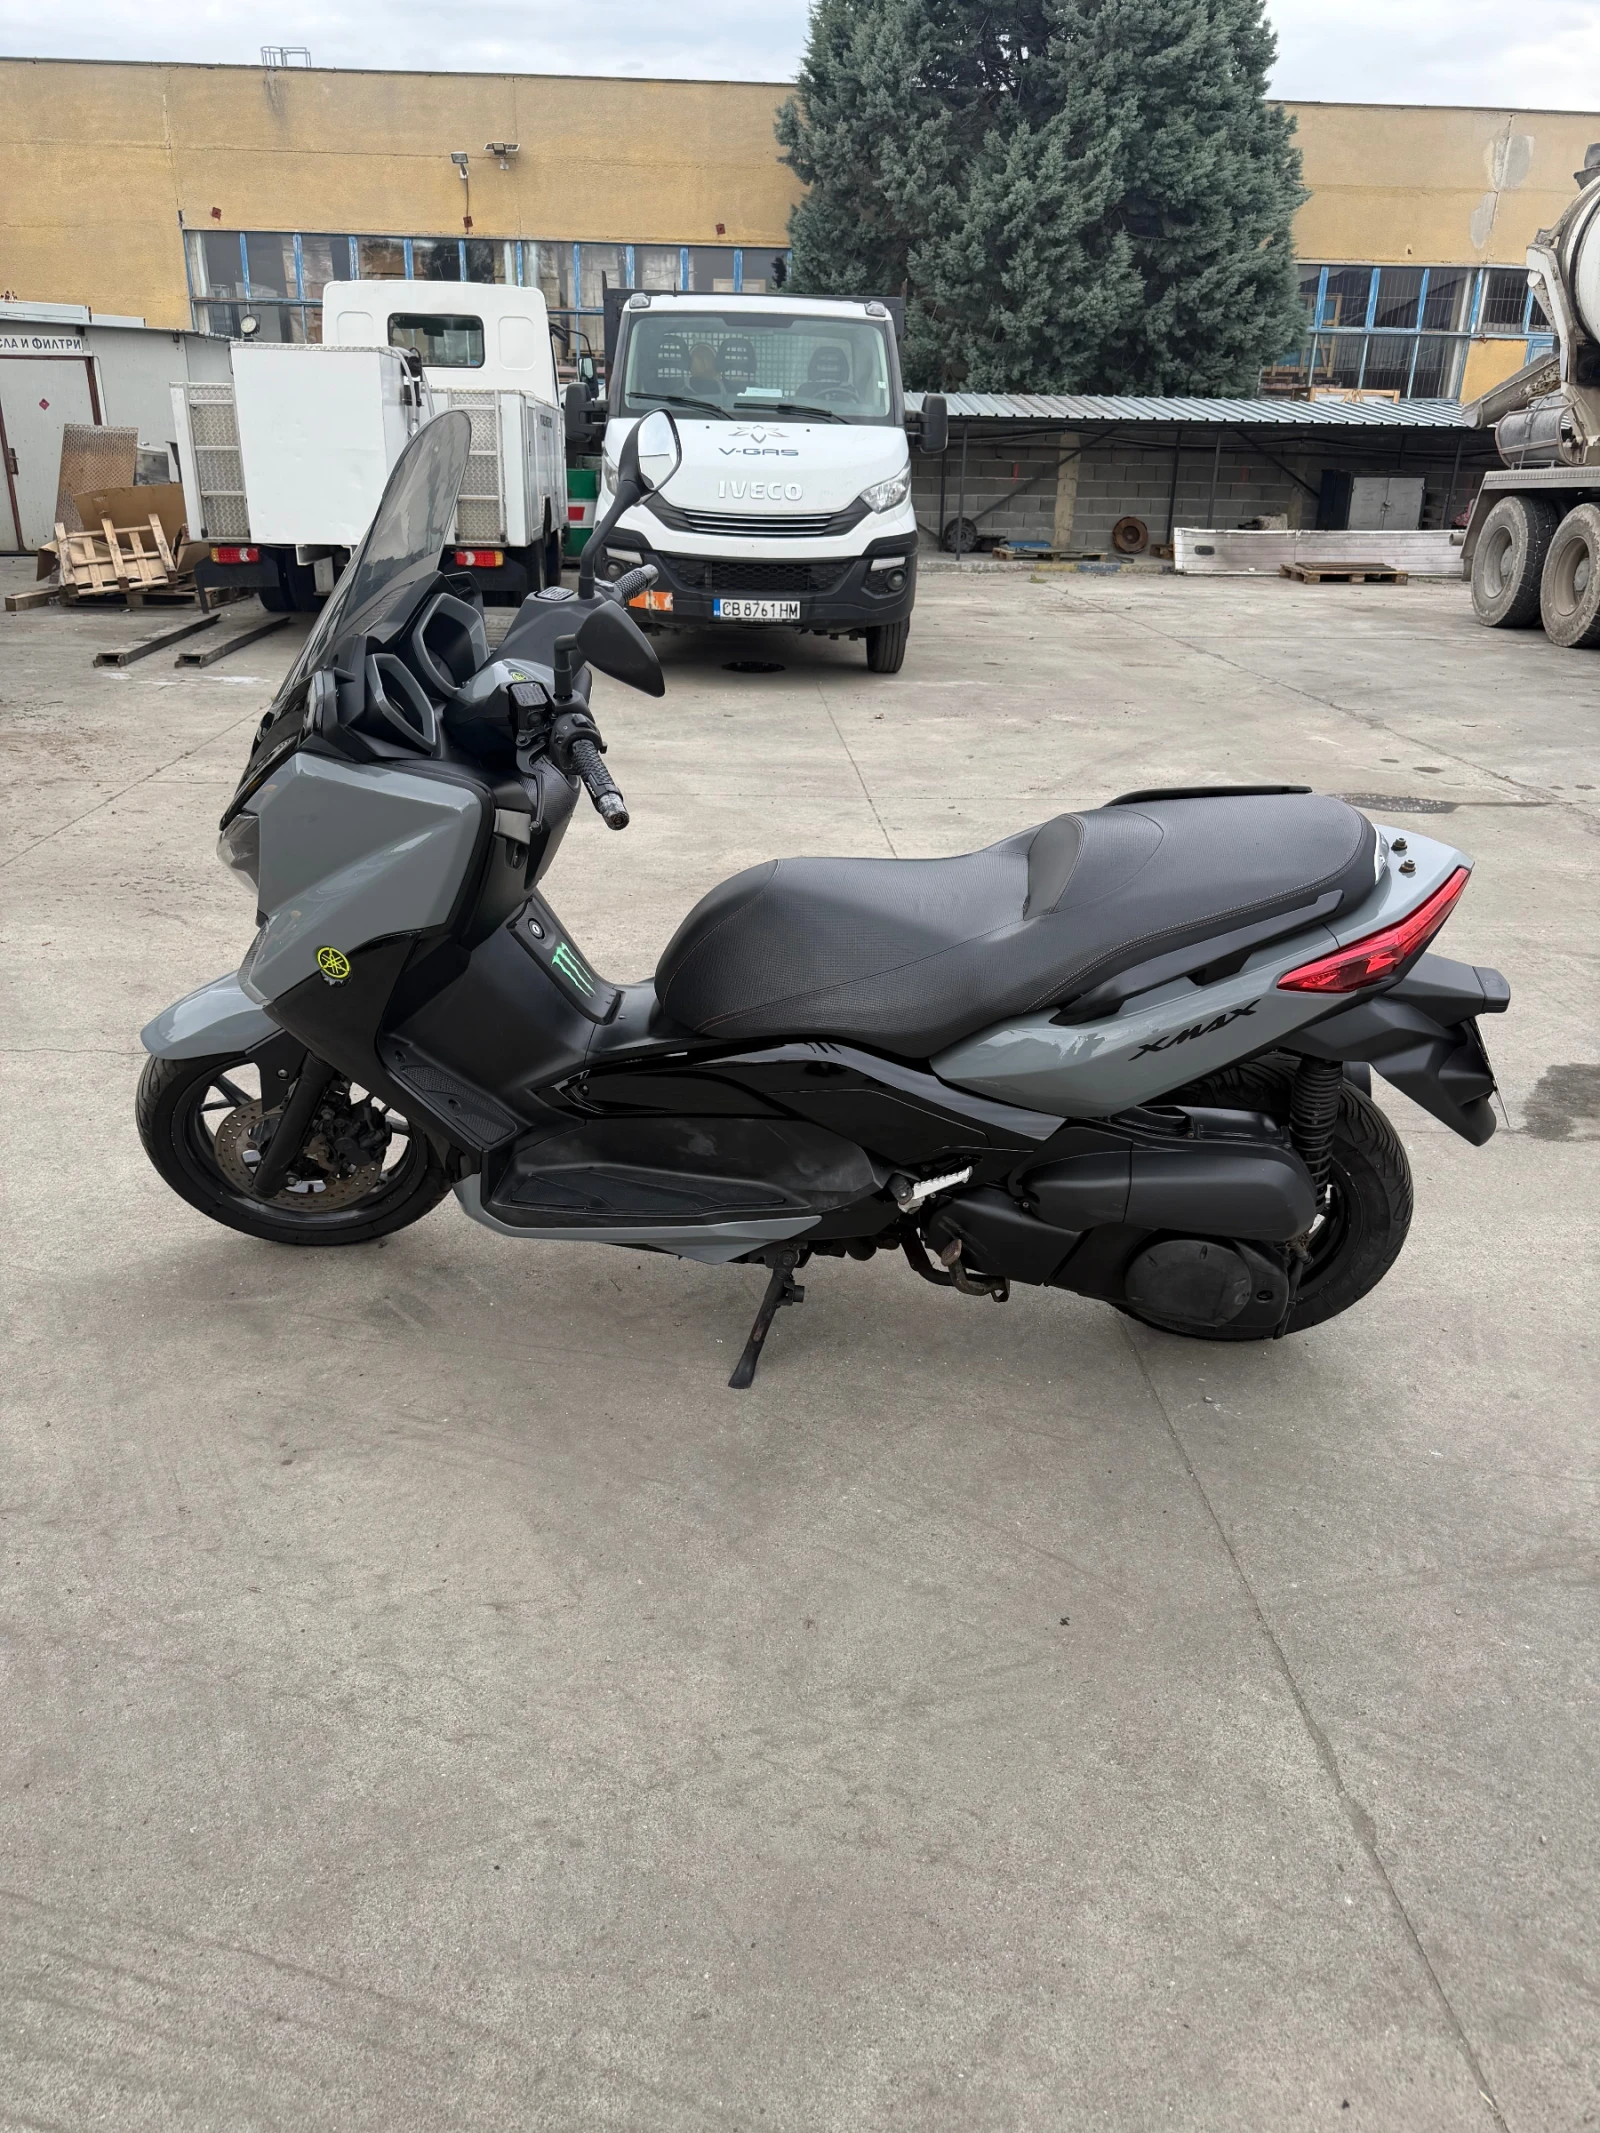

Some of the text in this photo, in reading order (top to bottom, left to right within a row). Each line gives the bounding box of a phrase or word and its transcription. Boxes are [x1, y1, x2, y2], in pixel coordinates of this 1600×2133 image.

[20, 338, 29, 349] И
[32, 337, 81, 349] ФИЛТРИ
[718, 447, 799, 456] V-GAS
[718, 480, 803, 501] IVECO
[743, 602, 776, 617] 8761
